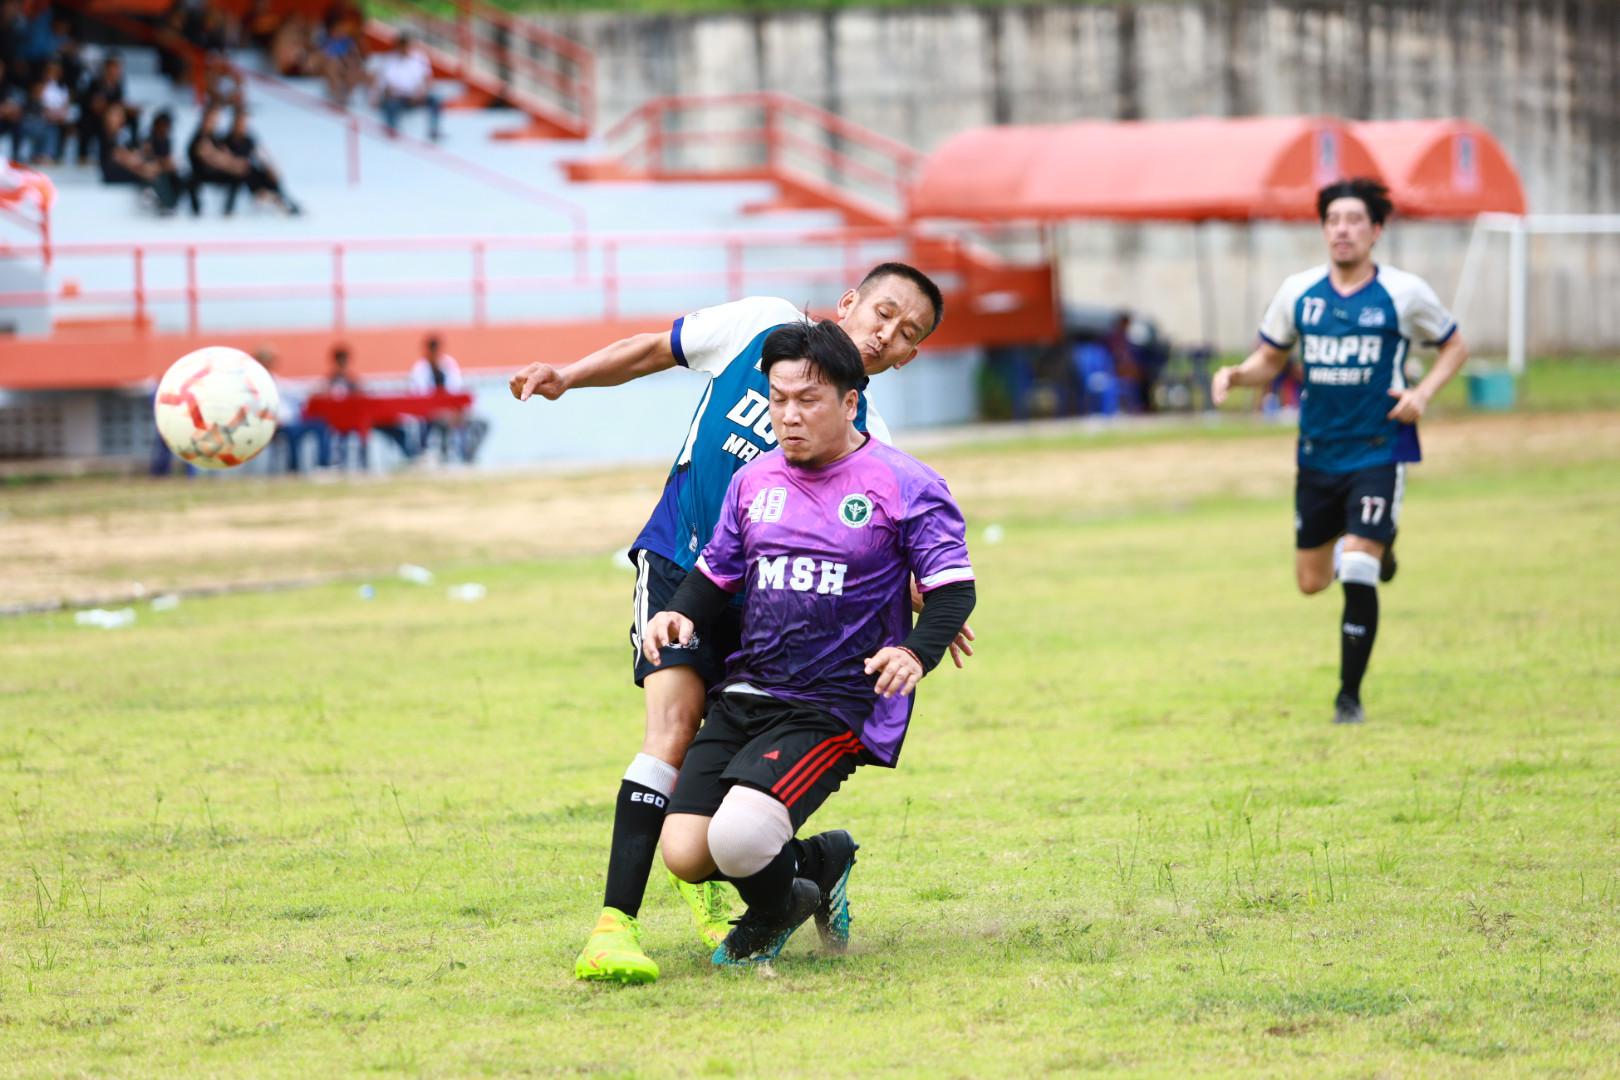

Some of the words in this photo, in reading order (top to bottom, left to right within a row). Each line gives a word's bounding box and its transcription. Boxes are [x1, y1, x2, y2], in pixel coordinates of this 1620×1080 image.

[1302, 296, 1327, 326] 17
[721, 432, 765, 464] MA
[748, 487, 787, 523] 48
[1360, 495, 1387, 526] 17
[757, 555, 848, 596] MSH
[630, 791, 665, 808] EGO
